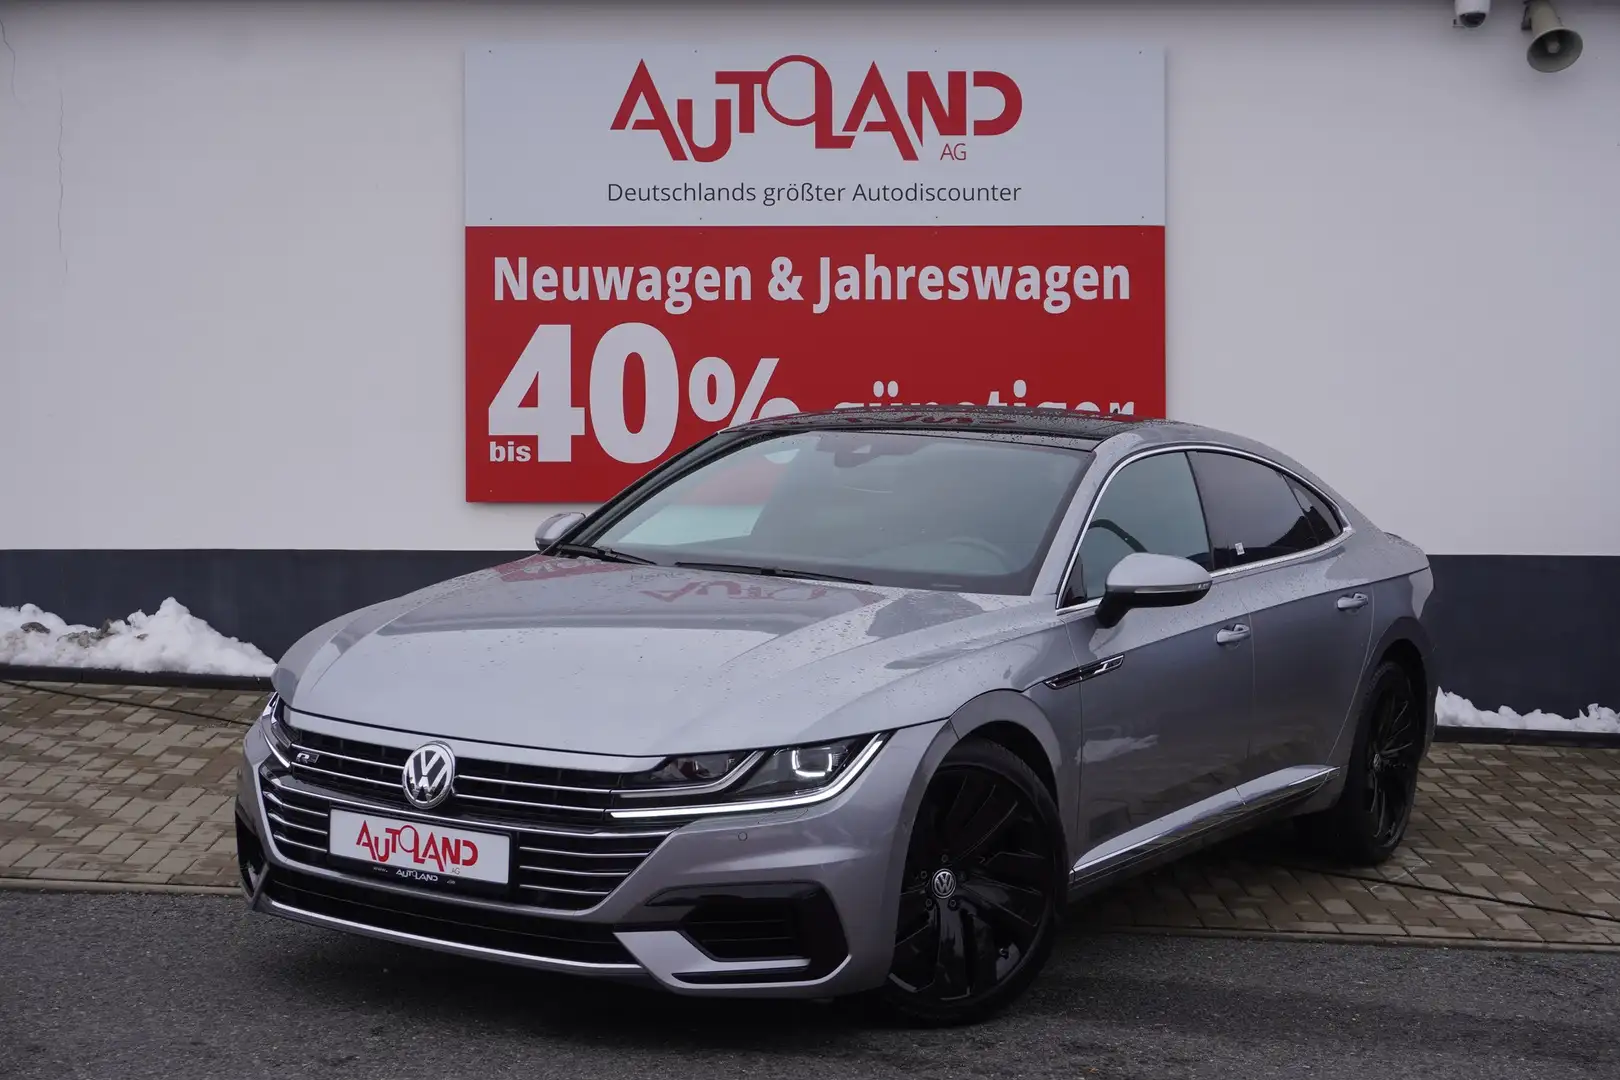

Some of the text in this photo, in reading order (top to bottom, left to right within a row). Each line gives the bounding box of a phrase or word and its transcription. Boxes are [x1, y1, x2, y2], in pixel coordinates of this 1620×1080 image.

[940, 143, 967, 161] AG
[607, 182, 1022, 207] Deutschlands größter Autodiscounter
[494, 253, 1130, 315] Neuwagen & Jahreswagen
[489, 440, 531, 463] bis
